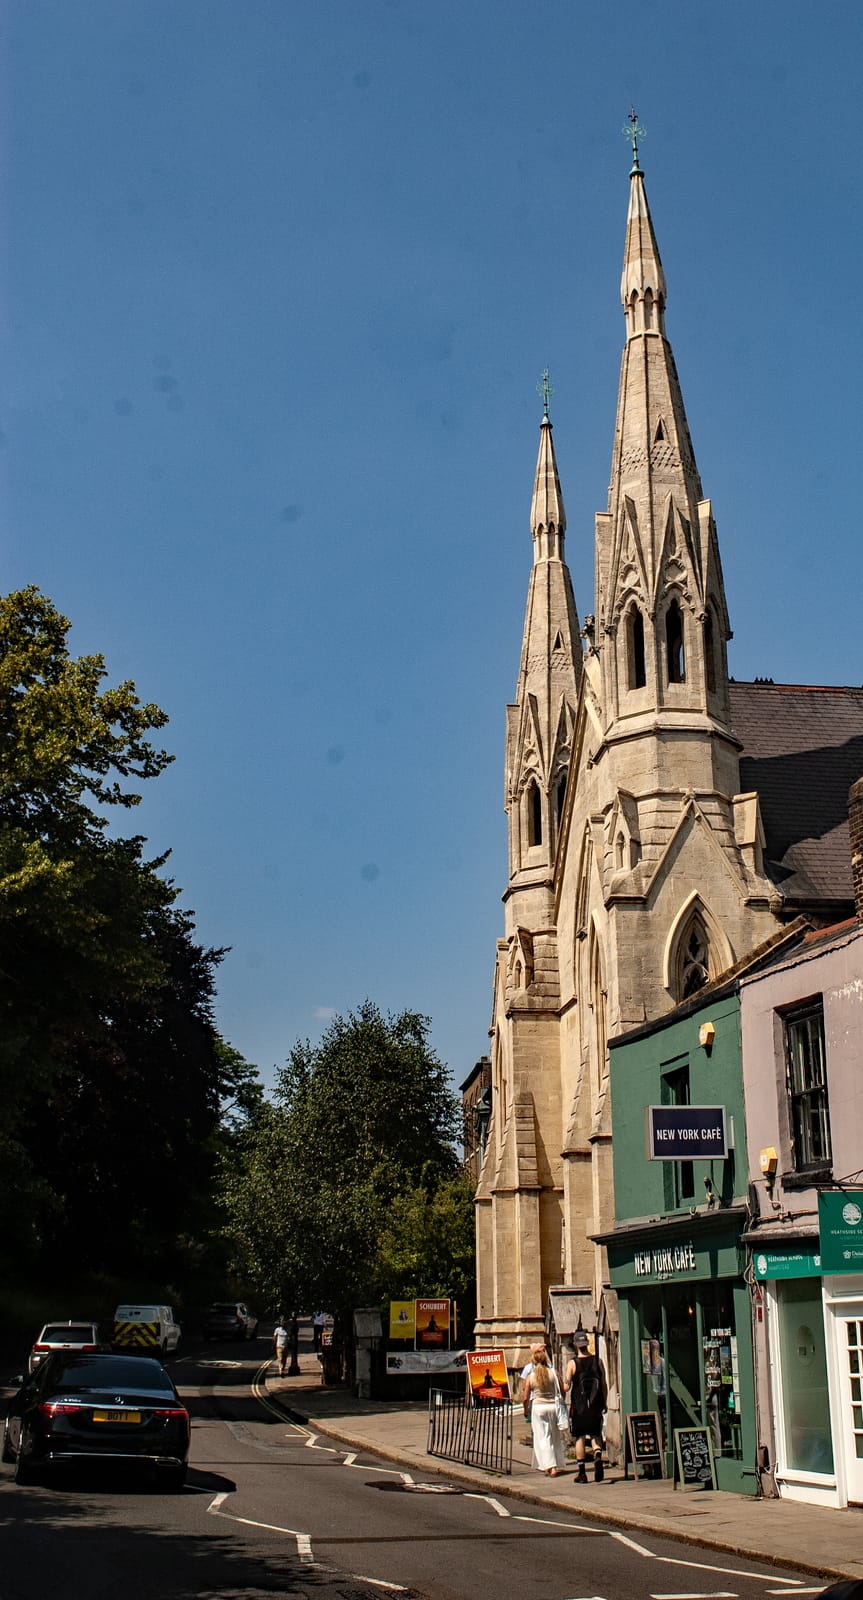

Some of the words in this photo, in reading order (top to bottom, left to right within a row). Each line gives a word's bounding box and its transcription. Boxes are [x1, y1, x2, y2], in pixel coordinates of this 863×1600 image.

[656, 1129, 675, 1140] NEW
[677, 1128, 699, 1140] YORK
[634, 1252, 651, 1275] NEW
[652, 1247, 674, 1272] YORK
[419, 1302, 447, 1311] SCHUBERT
[471, 1354, 501, 1365] SCHUBERT
